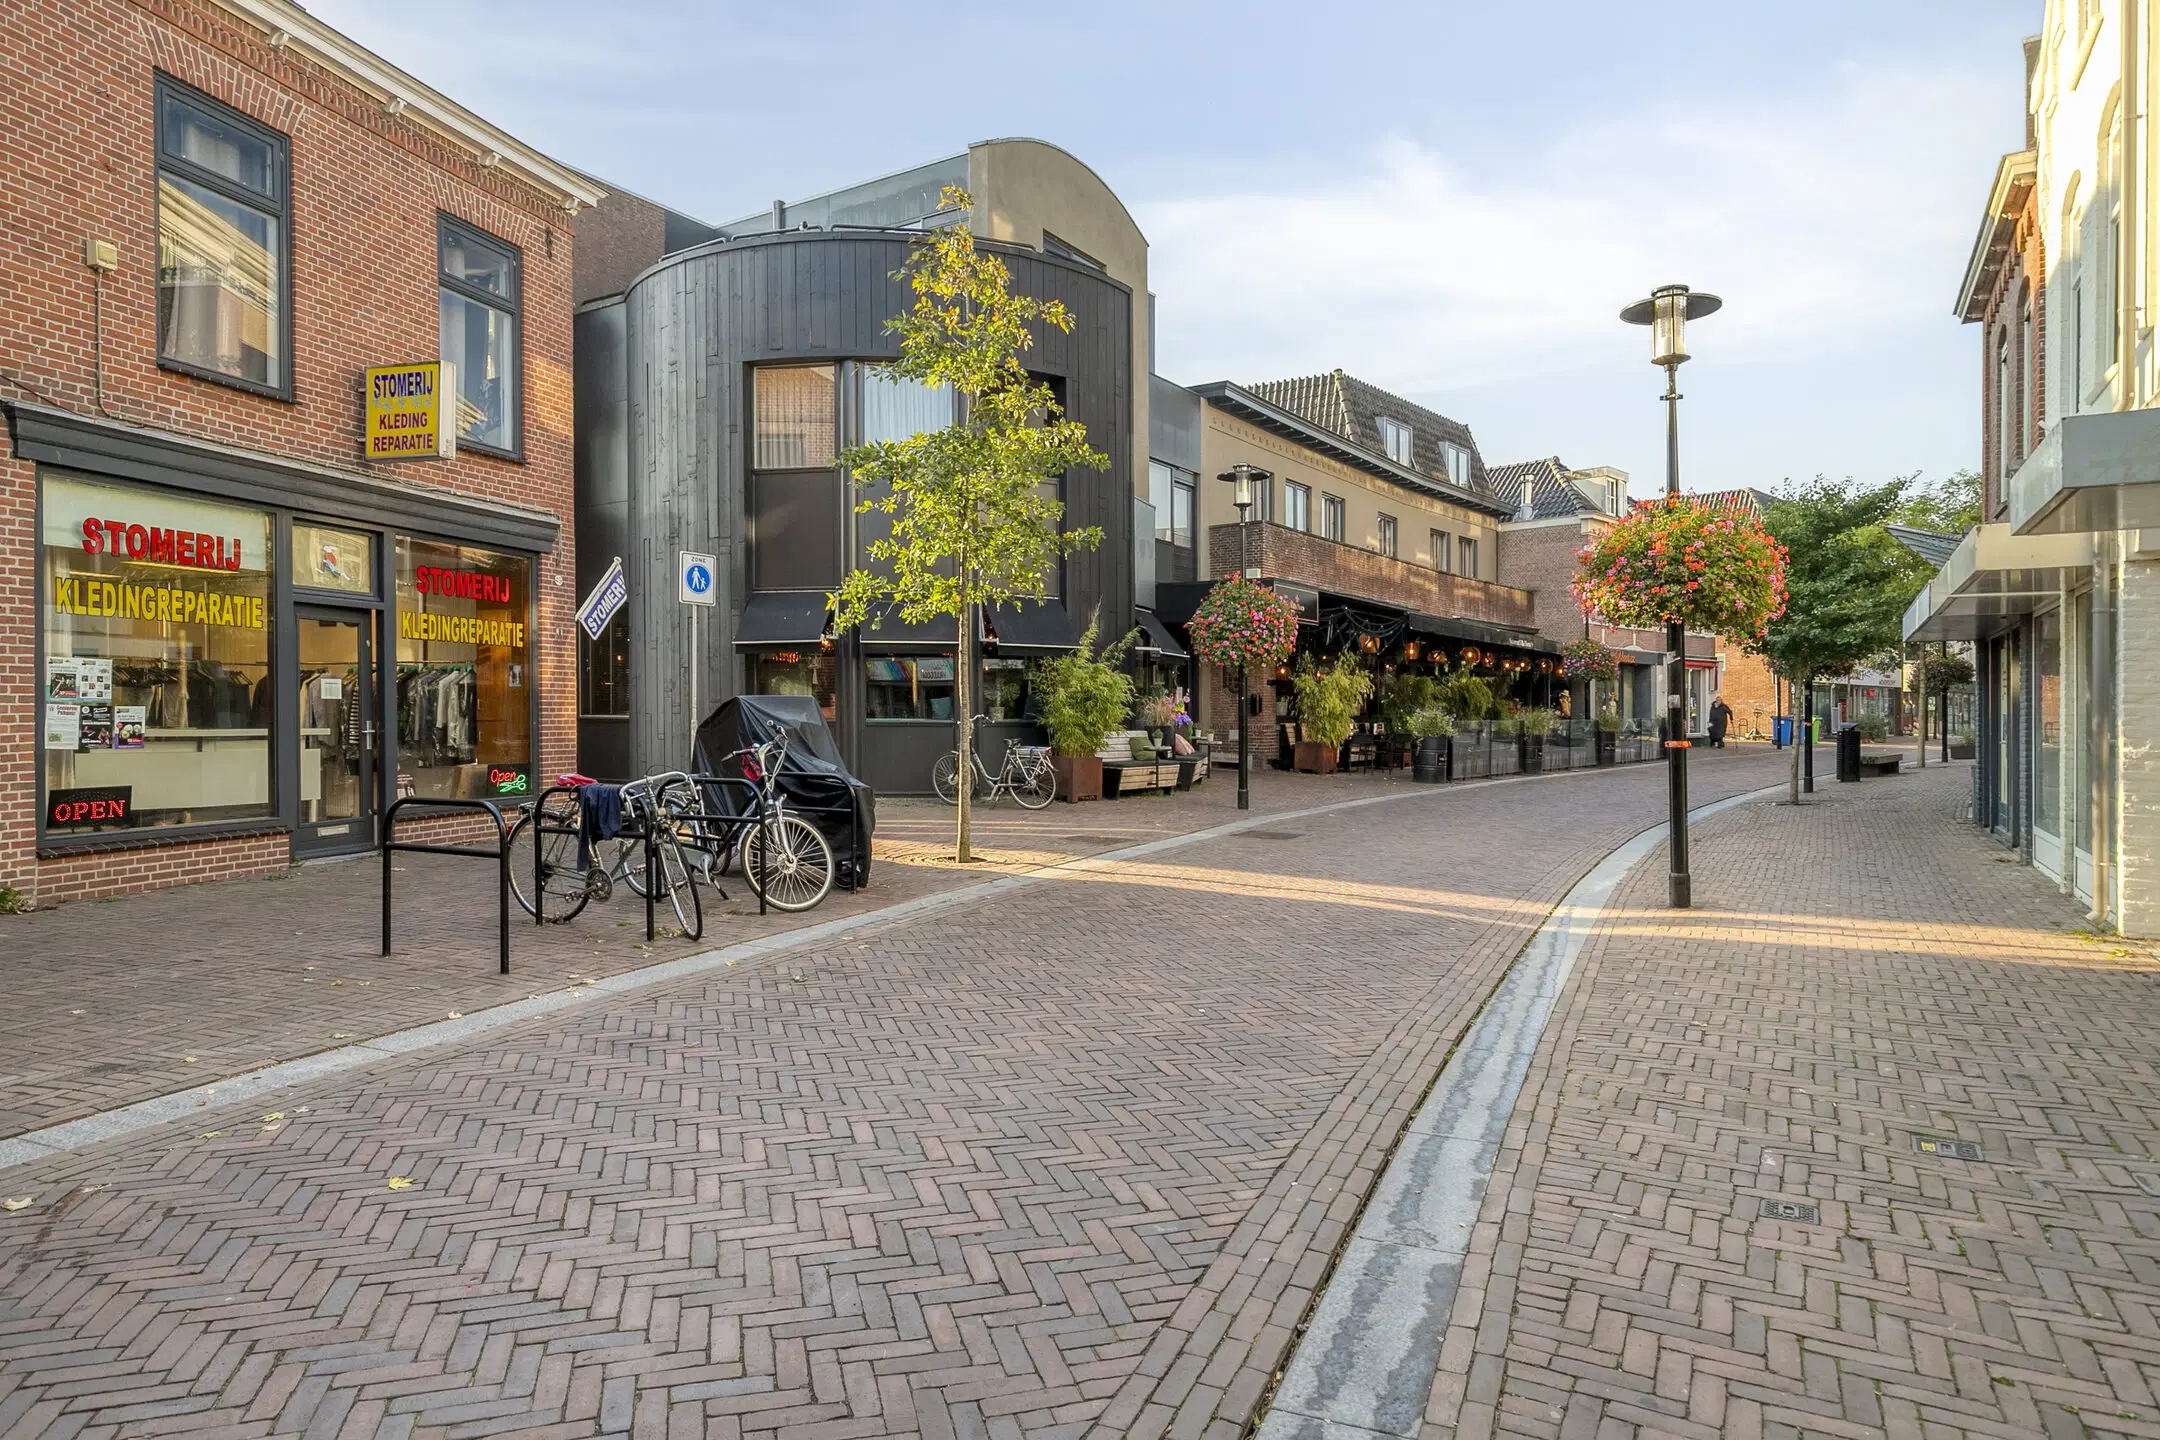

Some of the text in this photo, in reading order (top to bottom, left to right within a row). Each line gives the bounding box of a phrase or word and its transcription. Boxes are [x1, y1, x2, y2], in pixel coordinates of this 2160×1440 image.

[374, 370, 433, 399] STOMERIJ
[379, 412, 427, 430] KLEDING
[373, 433, 433, 452] REPARATIE
[82, 517, 241, 571] STOMERIJ
[416, 565, 511, 603] STOMERIJ
[55, 576, 263, 629] KLEDINGREPARATIE
[402, 610, 524, 648] KLEDINGREPARATIE
[490, 769, 516, 787] Open
[55, 800, 125, 821] OPEN
